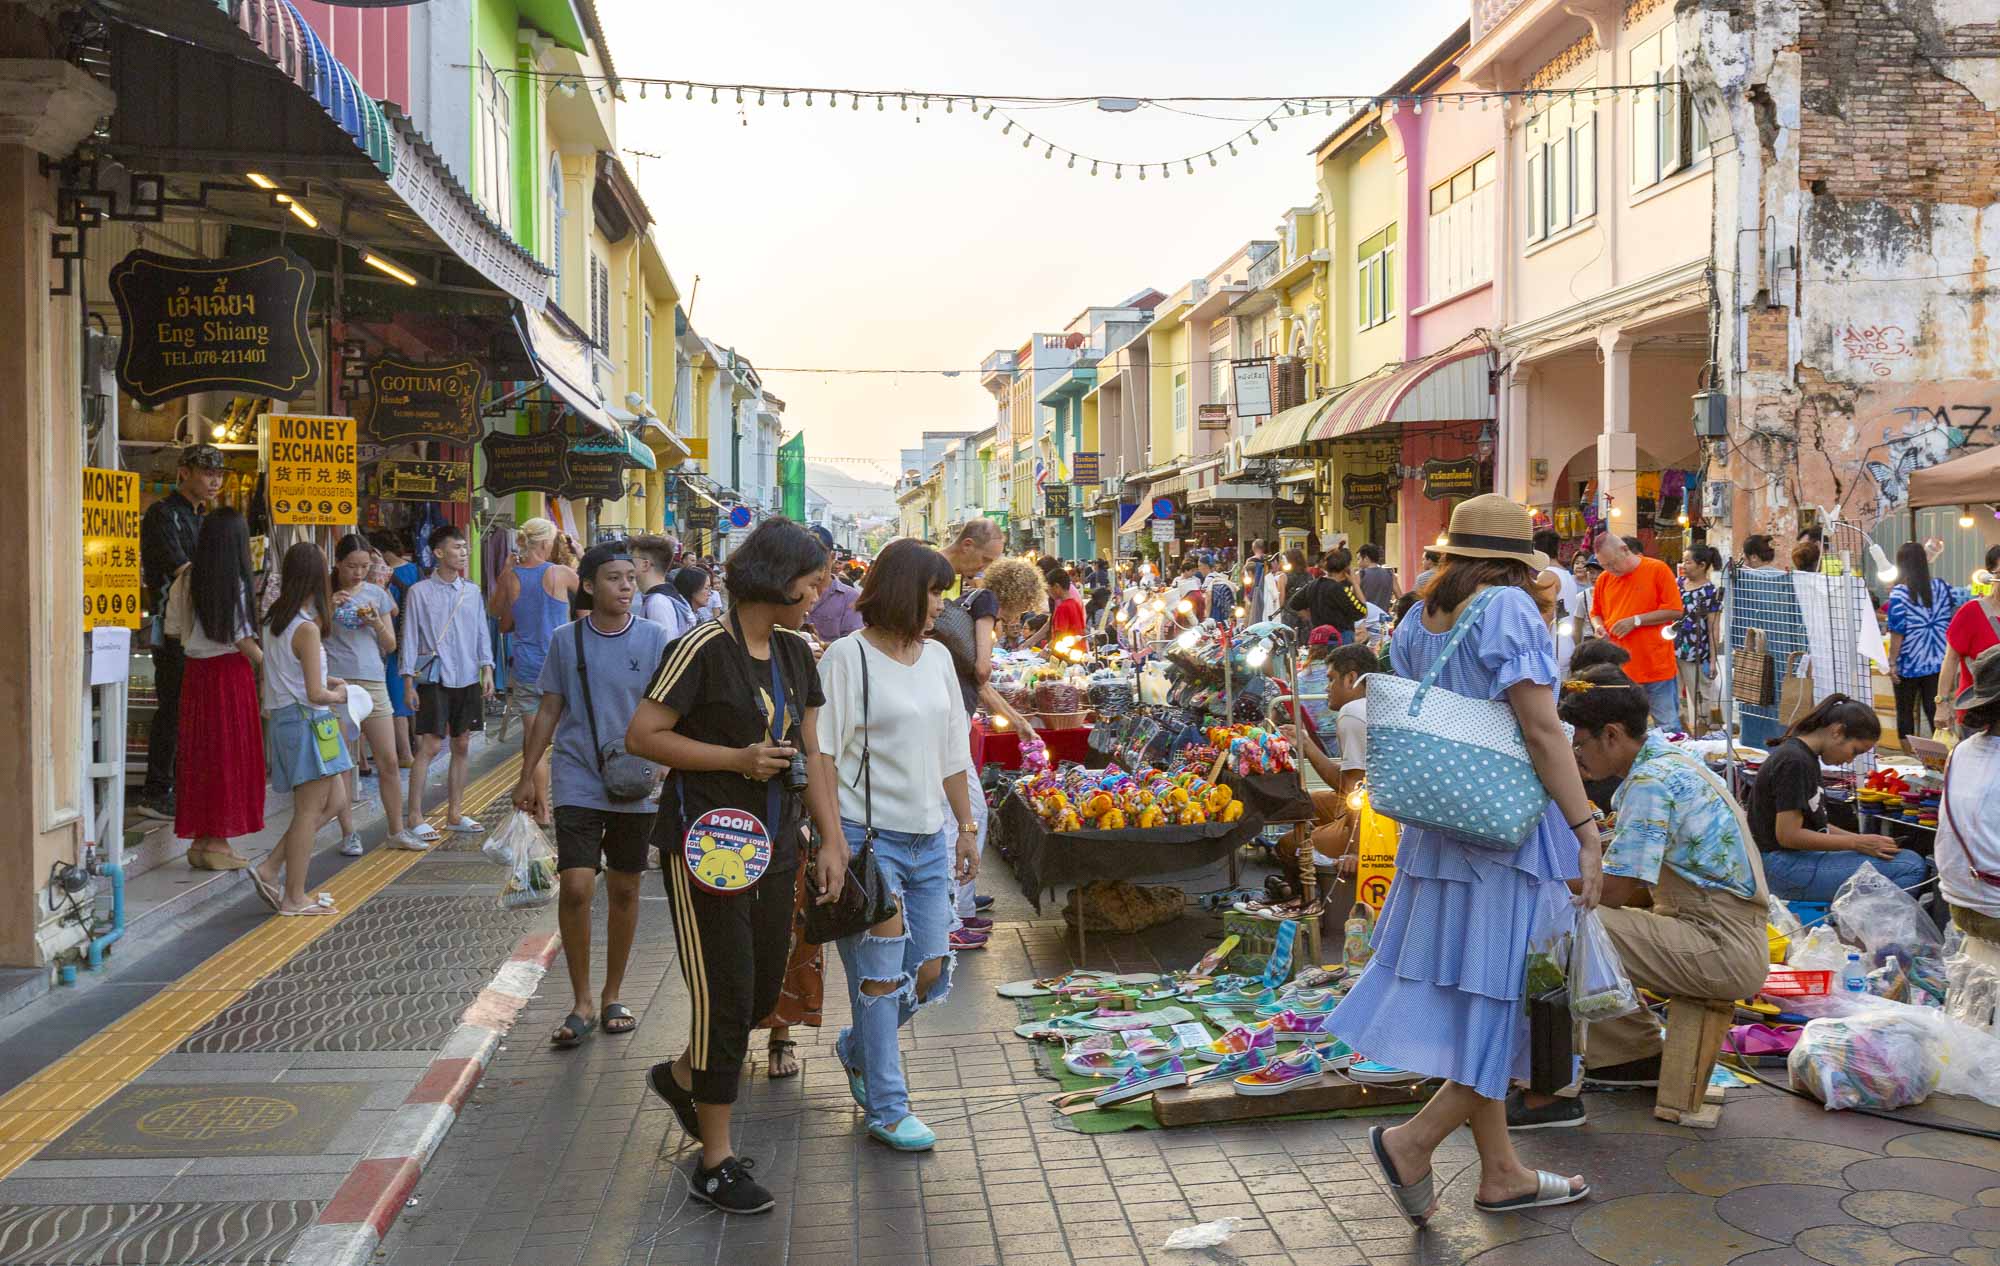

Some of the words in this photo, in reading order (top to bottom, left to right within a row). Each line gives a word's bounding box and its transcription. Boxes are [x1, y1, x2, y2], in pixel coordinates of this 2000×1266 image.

[158, 323, 196, 348] Eng
[203, 321, 270, 345] Shiang
[381, 376, 441, 392] GOTUM
[279, 419, 348, 441] MONEY
[272, 442, 354, 464] EXCHANGE
[275, 466, 353, 484] 货币兑换
[83, 471, 133, 504] MONEY
[292, 514, 316, 522] Better
[711, 815, 753, 831] POOH
[709, 831, 725, 839] LOVE
